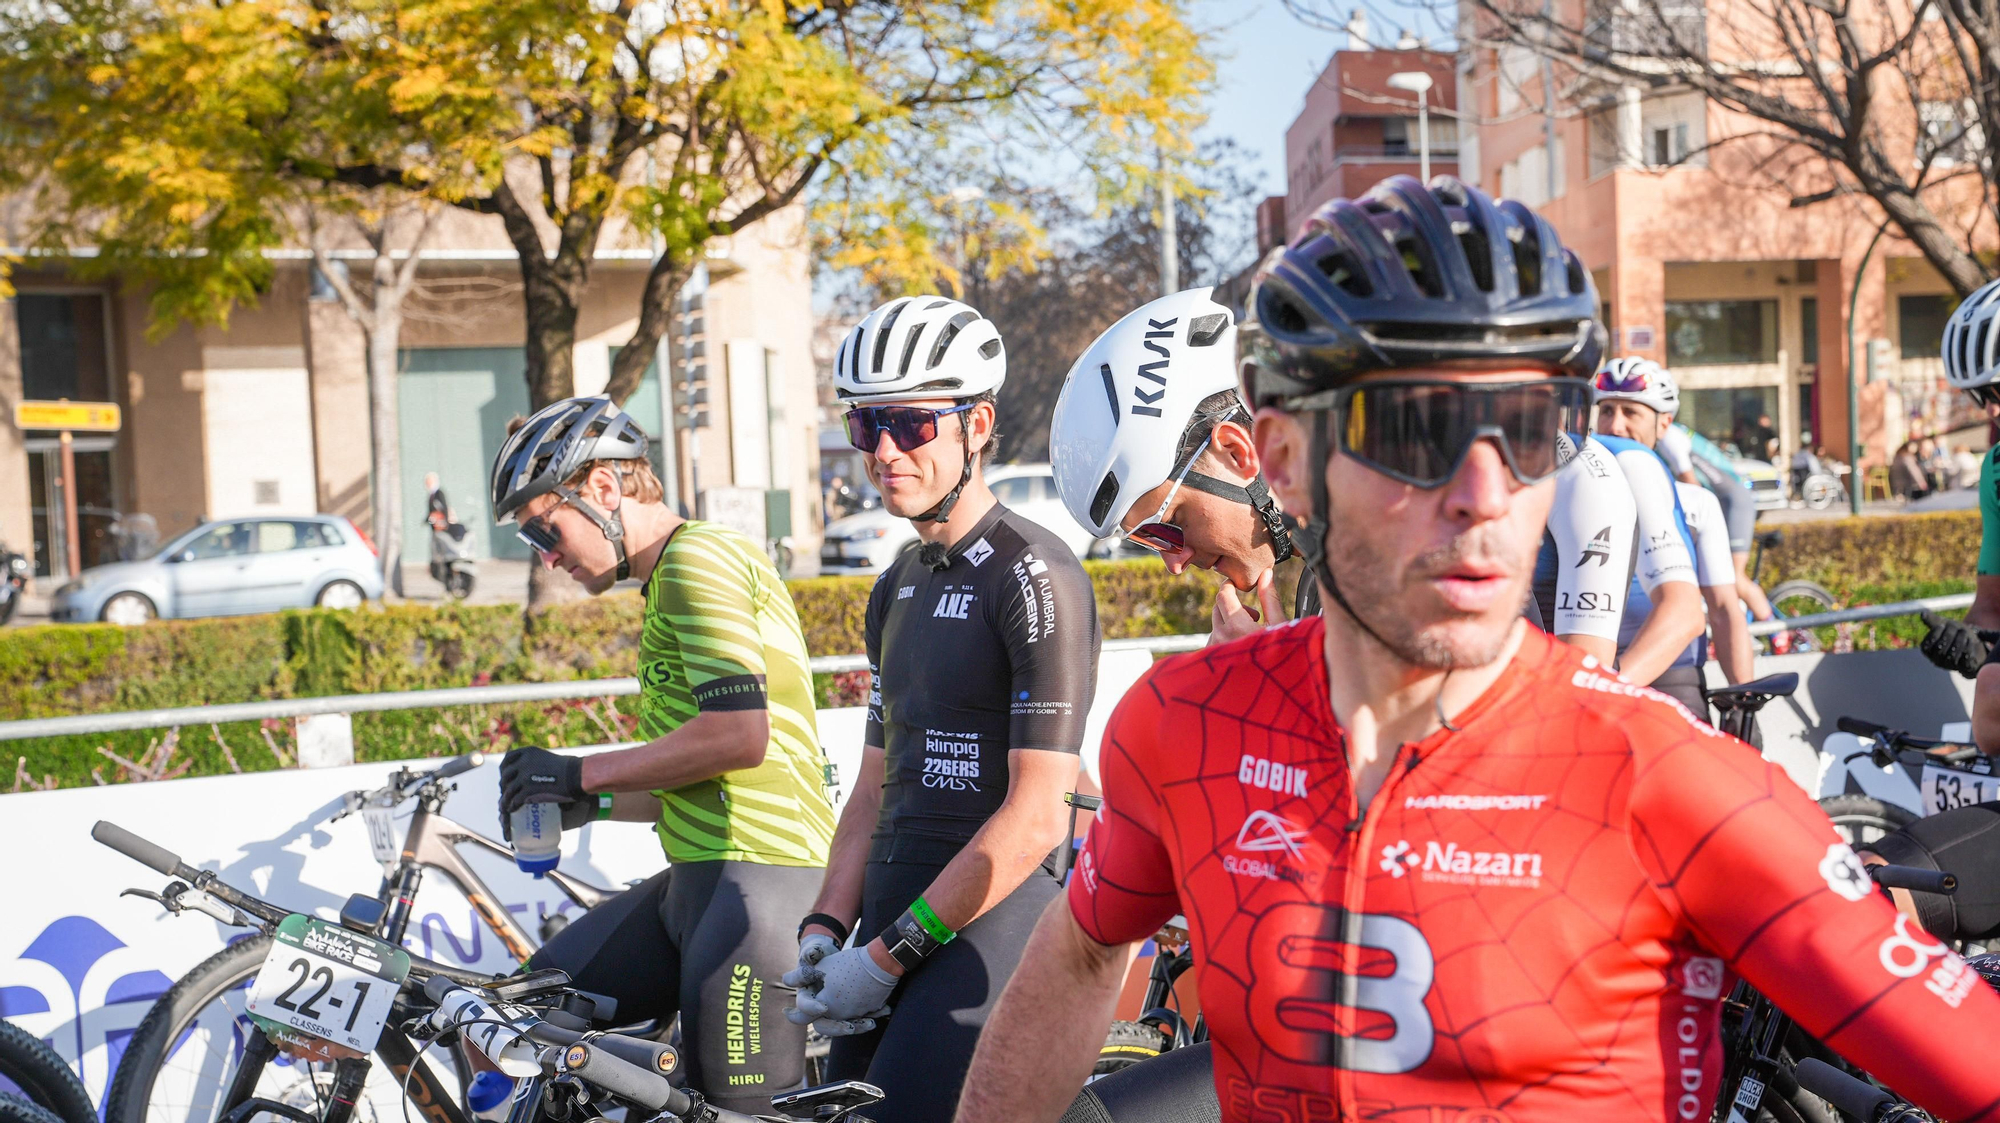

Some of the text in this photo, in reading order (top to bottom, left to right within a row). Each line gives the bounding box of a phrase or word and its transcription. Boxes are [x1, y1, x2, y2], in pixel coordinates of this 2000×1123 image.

[1131, 317, 1178, 418] KASK
[551, 433, 575, 477] LAZER
[897, 585, 916, 600] GOBIK
[1012, 561, 1039, 644] MADEINN
[925, 737, 980, 759] klinpig
[922, 757, 980, 778] 226ERS
[1238, 754, 1308, 798] GOBIK
[1223, 855, 1279, 881] GLOBAL
[302, 935, 328, 953] BIKE
[325, 944, 354, 963] RACE
[273, 958, 372, 1032] 22-1
[726, 963, 752, 1065] HENDRIKS
[748, 977, 764, 1055] WIELERSPORT
[290, 1016, 334, 1038] CLASSENS
[569, 1052, 583, 1061] ESI
[661, 1057, 674, 1065] ESI
[728, 1073, 765, 1086] HIRU
[1741, 1078, 1763, 1097] ROCK
[1736, 1090, 1759, 1107] SHOX
